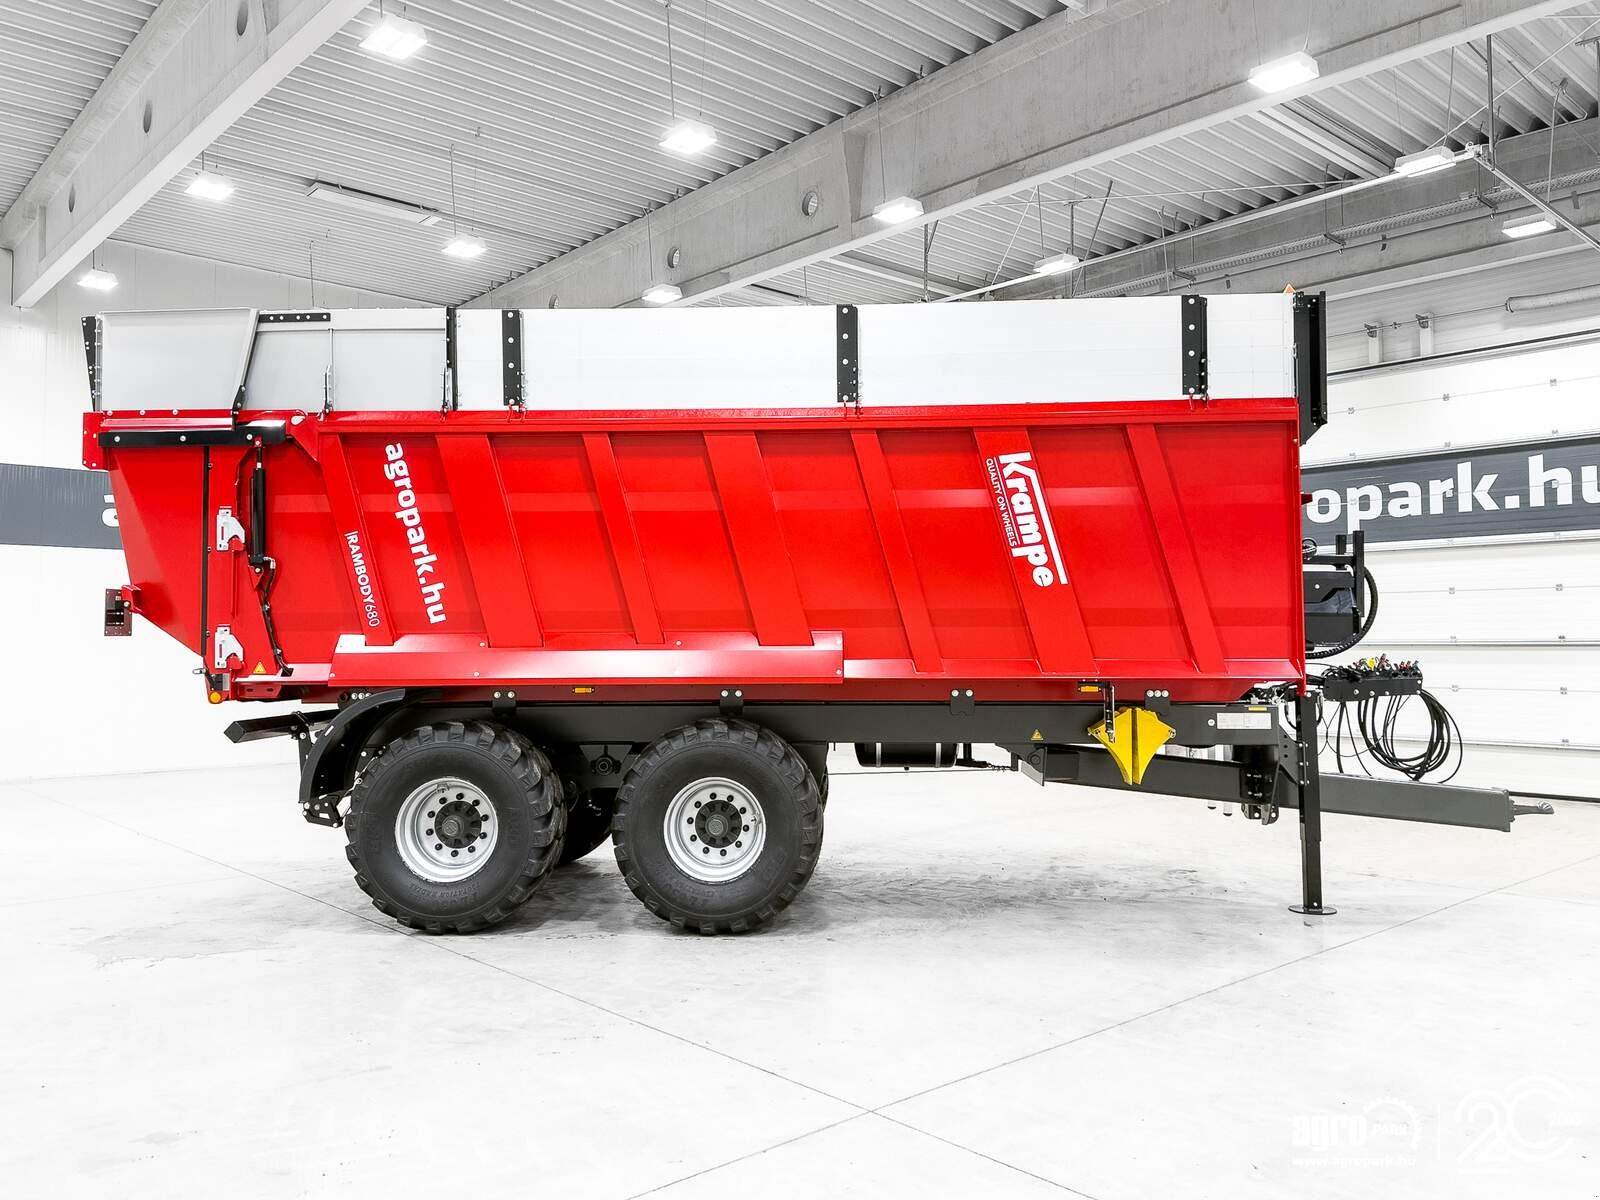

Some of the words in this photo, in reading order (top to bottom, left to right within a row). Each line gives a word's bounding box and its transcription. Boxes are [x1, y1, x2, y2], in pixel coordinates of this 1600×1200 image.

[985, 458, 1002, 495] QUALITY
[996, 495, 1007, 512] ON
[998, 451, 1069, 587] Krampe
[383, 442, 447, 625] agropark.hu
[1001, 511, 1018, 547] WHEELS
